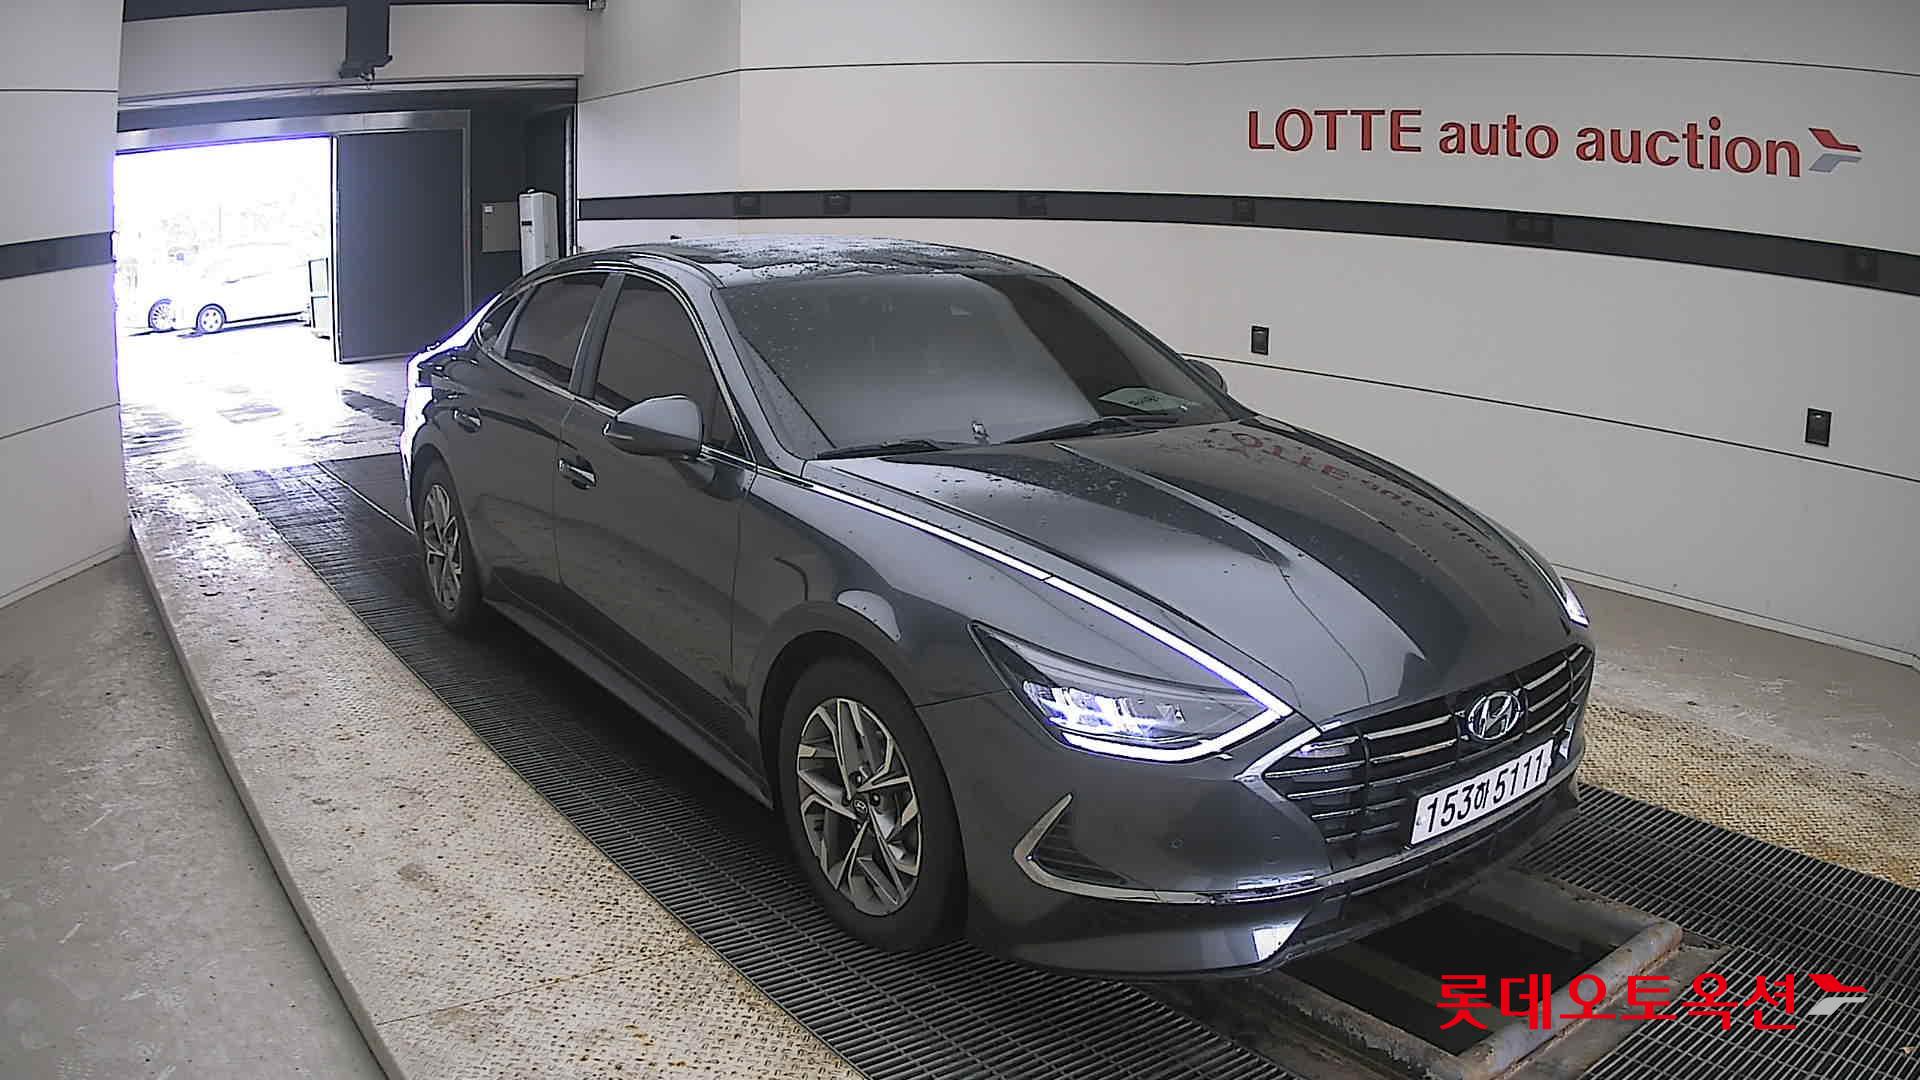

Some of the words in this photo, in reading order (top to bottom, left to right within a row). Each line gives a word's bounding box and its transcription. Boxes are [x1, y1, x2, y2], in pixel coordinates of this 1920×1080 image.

[1247, 109, 1423, 153] LOTTE
[1438, 115, 1559, 159] auto
[1575, 116, 1801, 178] auction
[1493, 748, 1545, 803] 5111
